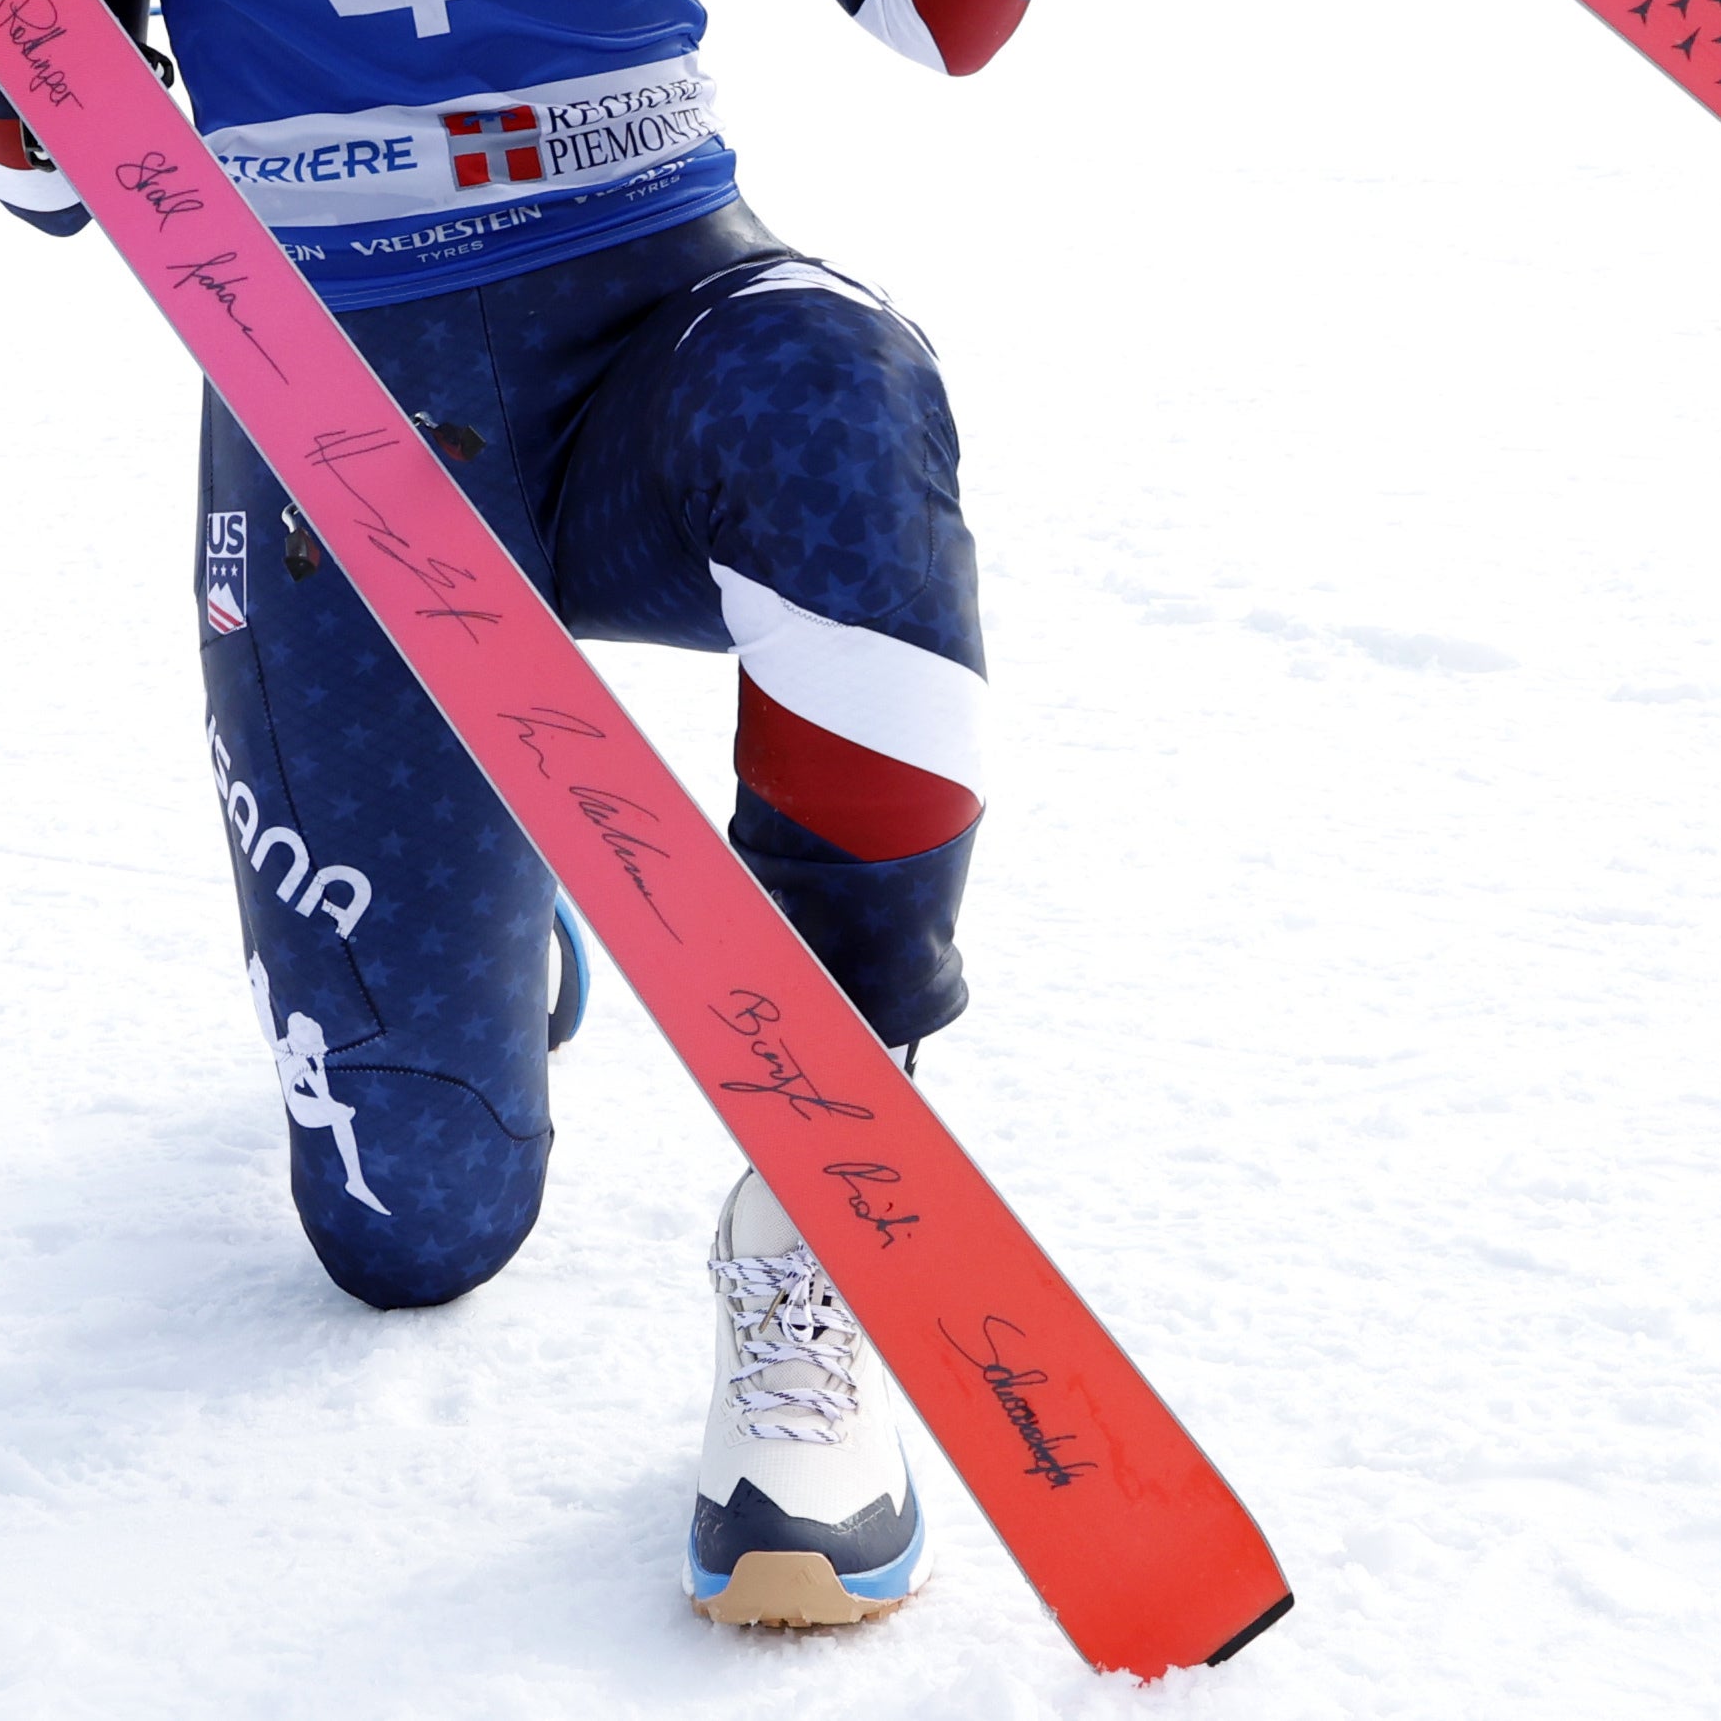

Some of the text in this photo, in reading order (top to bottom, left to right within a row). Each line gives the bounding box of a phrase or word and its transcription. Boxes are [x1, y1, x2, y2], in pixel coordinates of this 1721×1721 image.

[217, 135, 418, 184] TRIERE
[545, 107, 717, 176] PIEMONTE
[349, 204, 545, 257] VREDESTEIN
[417, 239, 485, 264] TYRES
[208, 513, 245, 556] US
